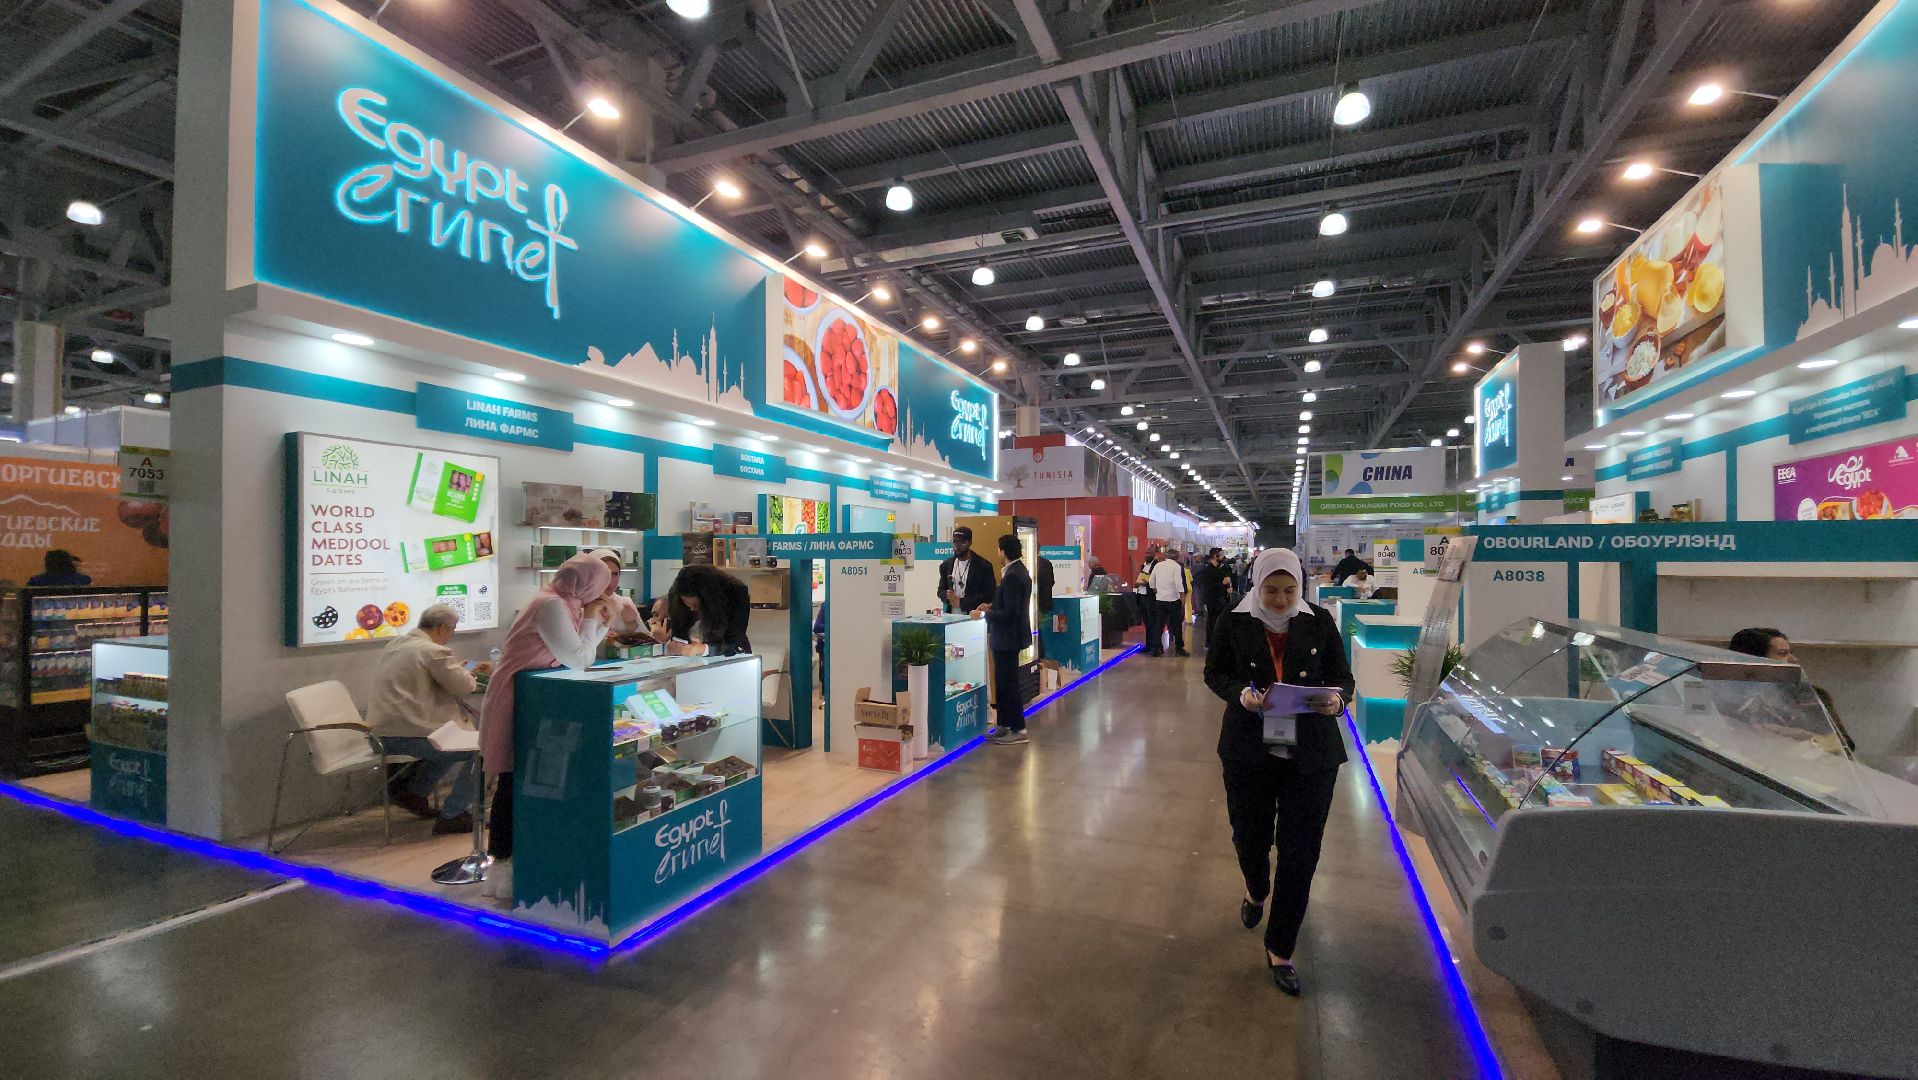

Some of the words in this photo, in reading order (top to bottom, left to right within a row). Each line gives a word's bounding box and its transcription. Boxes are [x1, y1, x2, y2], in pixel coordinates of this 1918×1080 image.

[338, 88, 529, 214] Egypt
[466, 399, 501, 416] LINAH
[502, 407, 538, 422] FARMS
[465, 417, 498, 432] ЛИНА
[499, 423, 539, 438] ФАРМС
[141, 457, 153, 467] A
[129, 467, 164, 480] 7053
[313, 470, 368, 486] LINAH
[1034, 470, 1073, 480] TUNISIA
[1362, 465, 1413, 482] CHINA
[311, 504, 375, 518] WORLD
[311, 521, 363, 534] CLASS
[311, 538, 390, 551] MEDJOOL
[772, 541, 802, 551] FARMS
[809, 541, 836, 551] ЛИНА
[838, 540, 874, 550] ФАРМС
[900, 540, 906, 548] A
[1440, 536, 1450, 545] A
[1483, 535, 1594, 549] OBOURLAND
[1610, 534, 1736, 550] ОБОУРЛЭНД
[312, 554, 363, 566] DATES
[841, 567, 868, 575] A8051
[1493, 570, 1545, 582] A8038
[655, 810, 713, 850] Egypt
